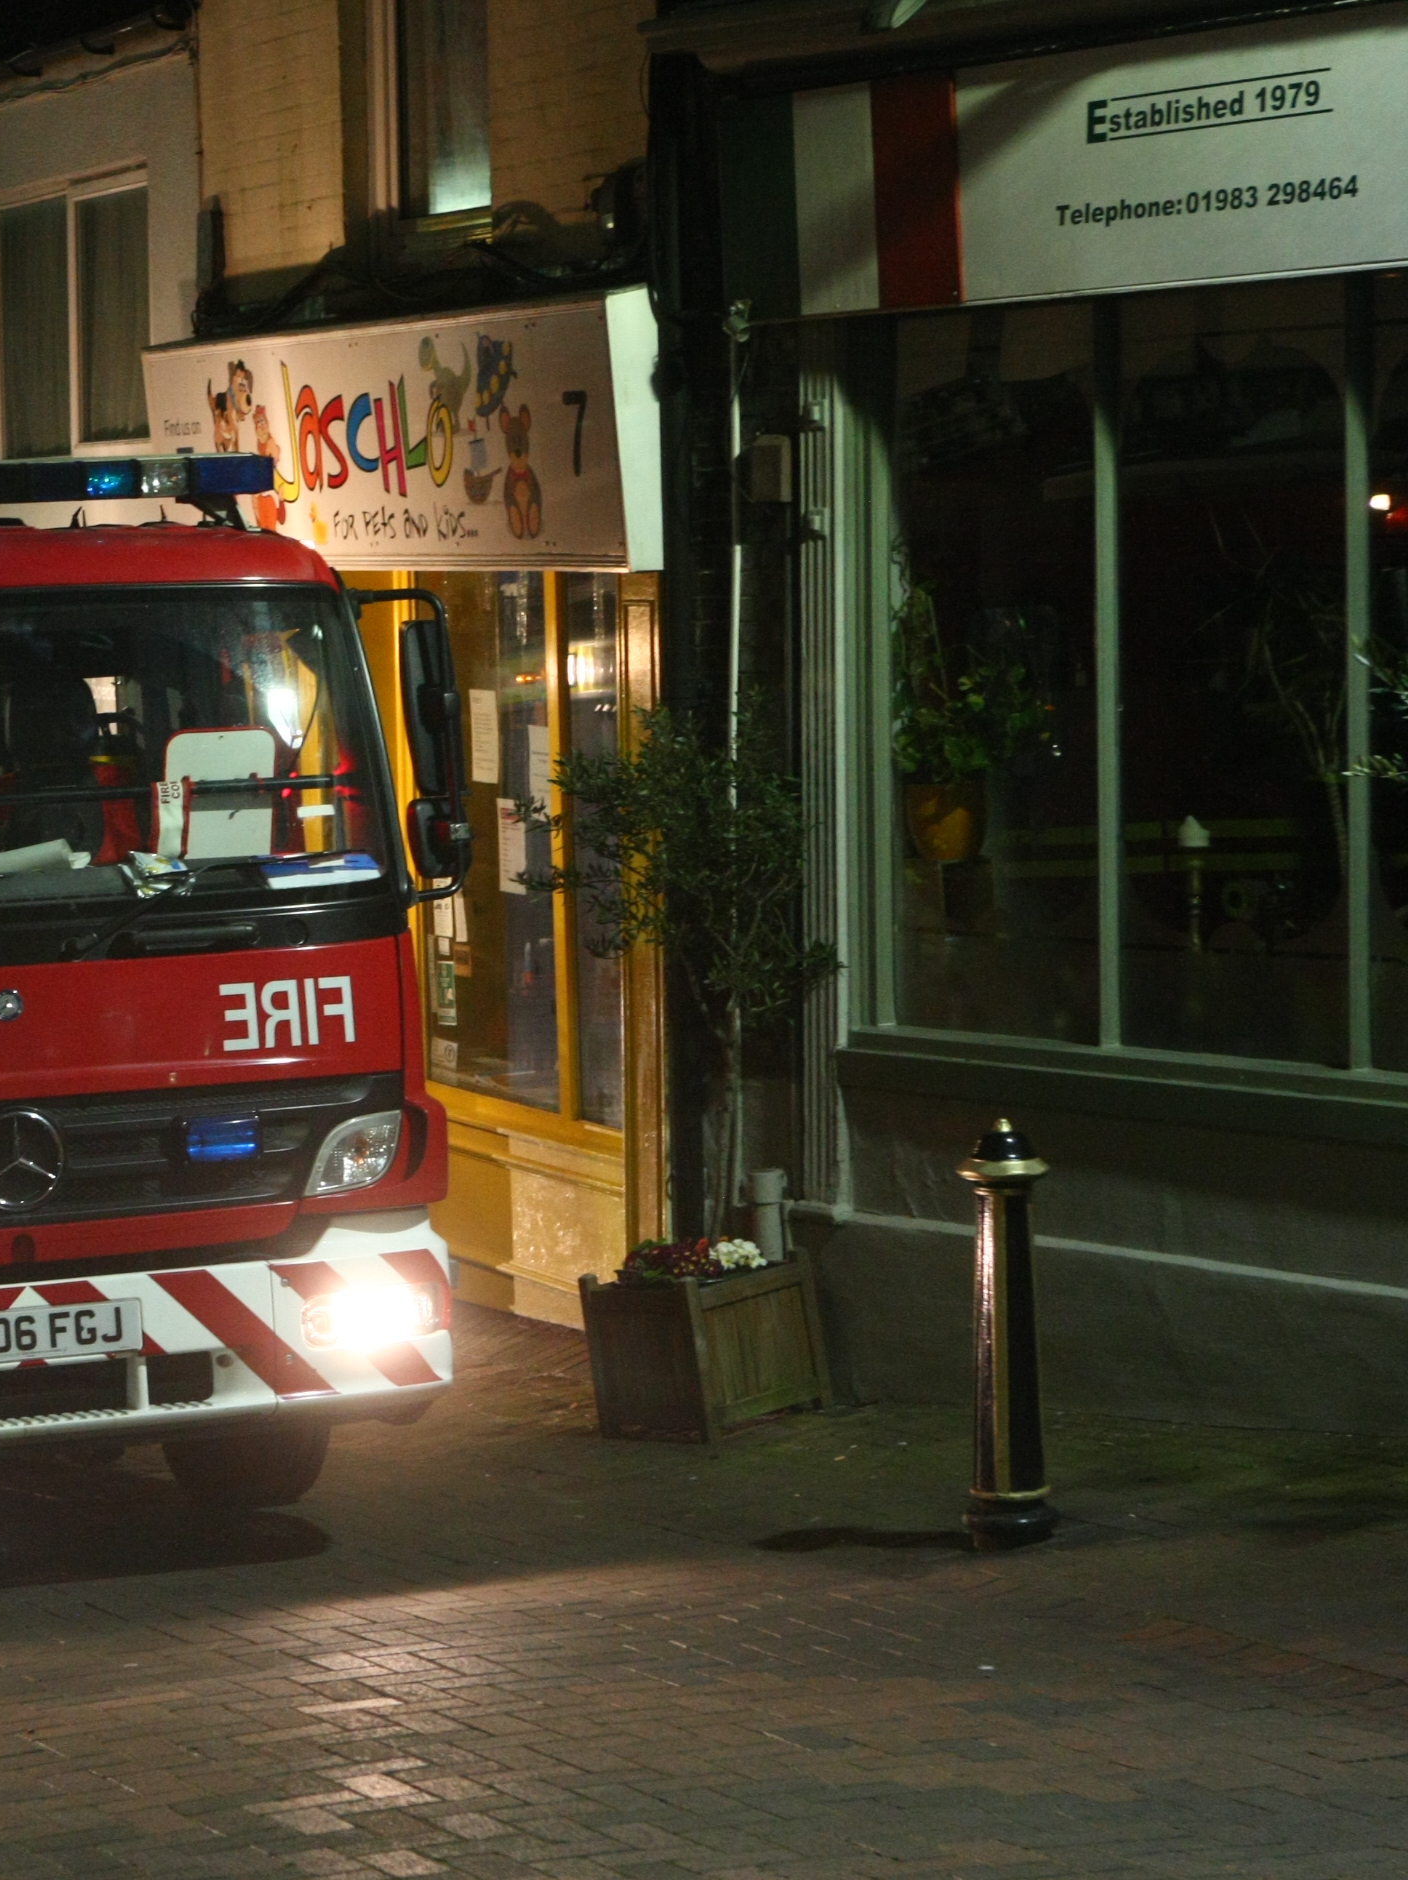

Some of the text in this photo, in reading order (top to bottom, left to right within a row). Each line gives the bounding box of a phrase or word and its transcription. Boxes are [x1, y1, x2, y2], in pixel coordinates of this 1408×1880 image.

[1086, 80, 1321, 144] Established 1979
[1266, 174, 1359, 206] 298464
[562, 390, 587, 477] 7
[49, 1306, 122, 1349] FGJ
